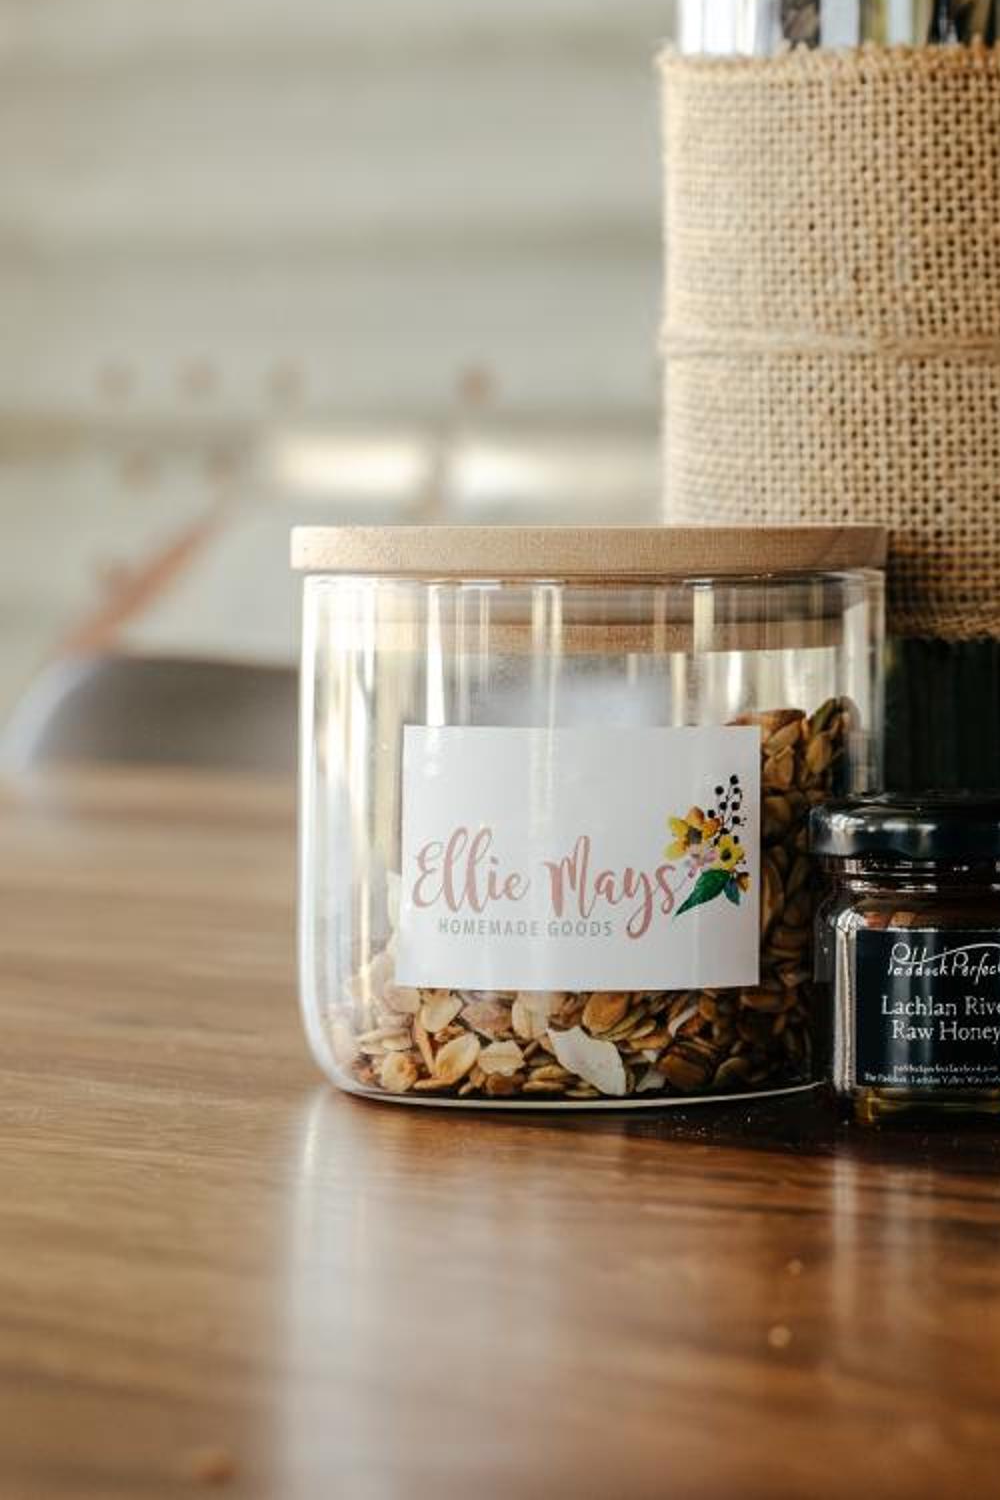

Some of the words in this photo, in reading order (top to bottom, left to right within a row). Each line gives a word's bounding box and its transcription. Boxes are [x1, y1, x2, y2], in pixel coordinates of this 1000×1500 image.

[411, 826, 531, 914] Ellie
[543, 835, 682, 940] Mays
[438, 918, 540, 937] HOMEMADE
[546, 920, 613, 937] GOODS
[880, 995, 957, 1016] Lachlan
[891, 1019, 934, 1040] Raw
